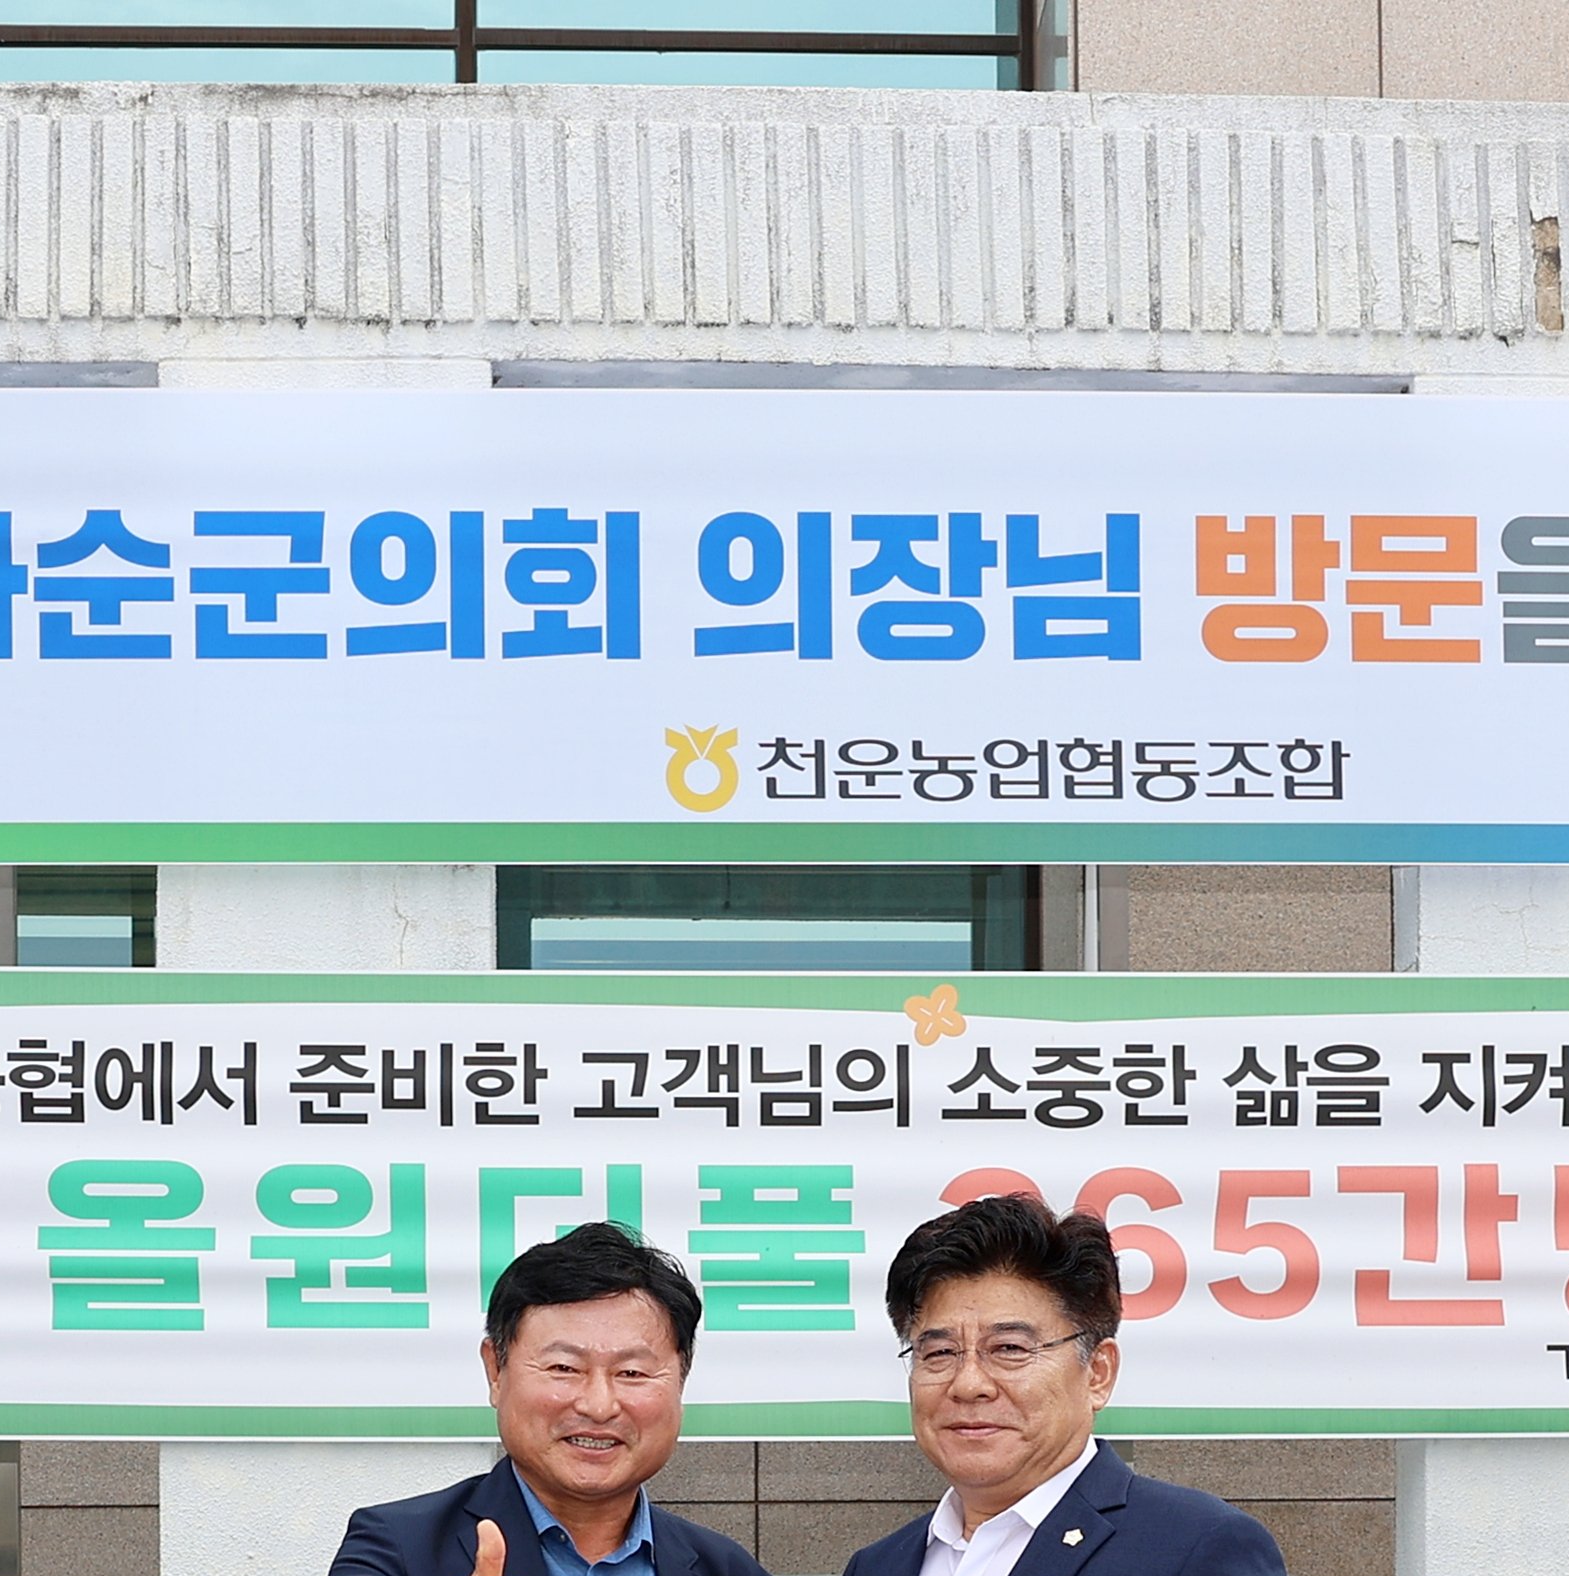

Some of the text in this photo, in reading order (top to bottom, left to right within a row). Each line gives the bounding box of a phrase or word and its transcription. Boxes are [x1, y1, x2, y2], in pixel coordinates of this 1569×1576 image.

[695, 512, 1141, 660] 의장님
[758, 738, 1350, 802] 천운농업협동조합
[290, 1043, 547, 1126] 준비한
[574, 1044, 909, 1127] 고객님의
[942, 1045, 1196, 1128] 소중한
[1223, 1045, 1389, 1126] 삶을
